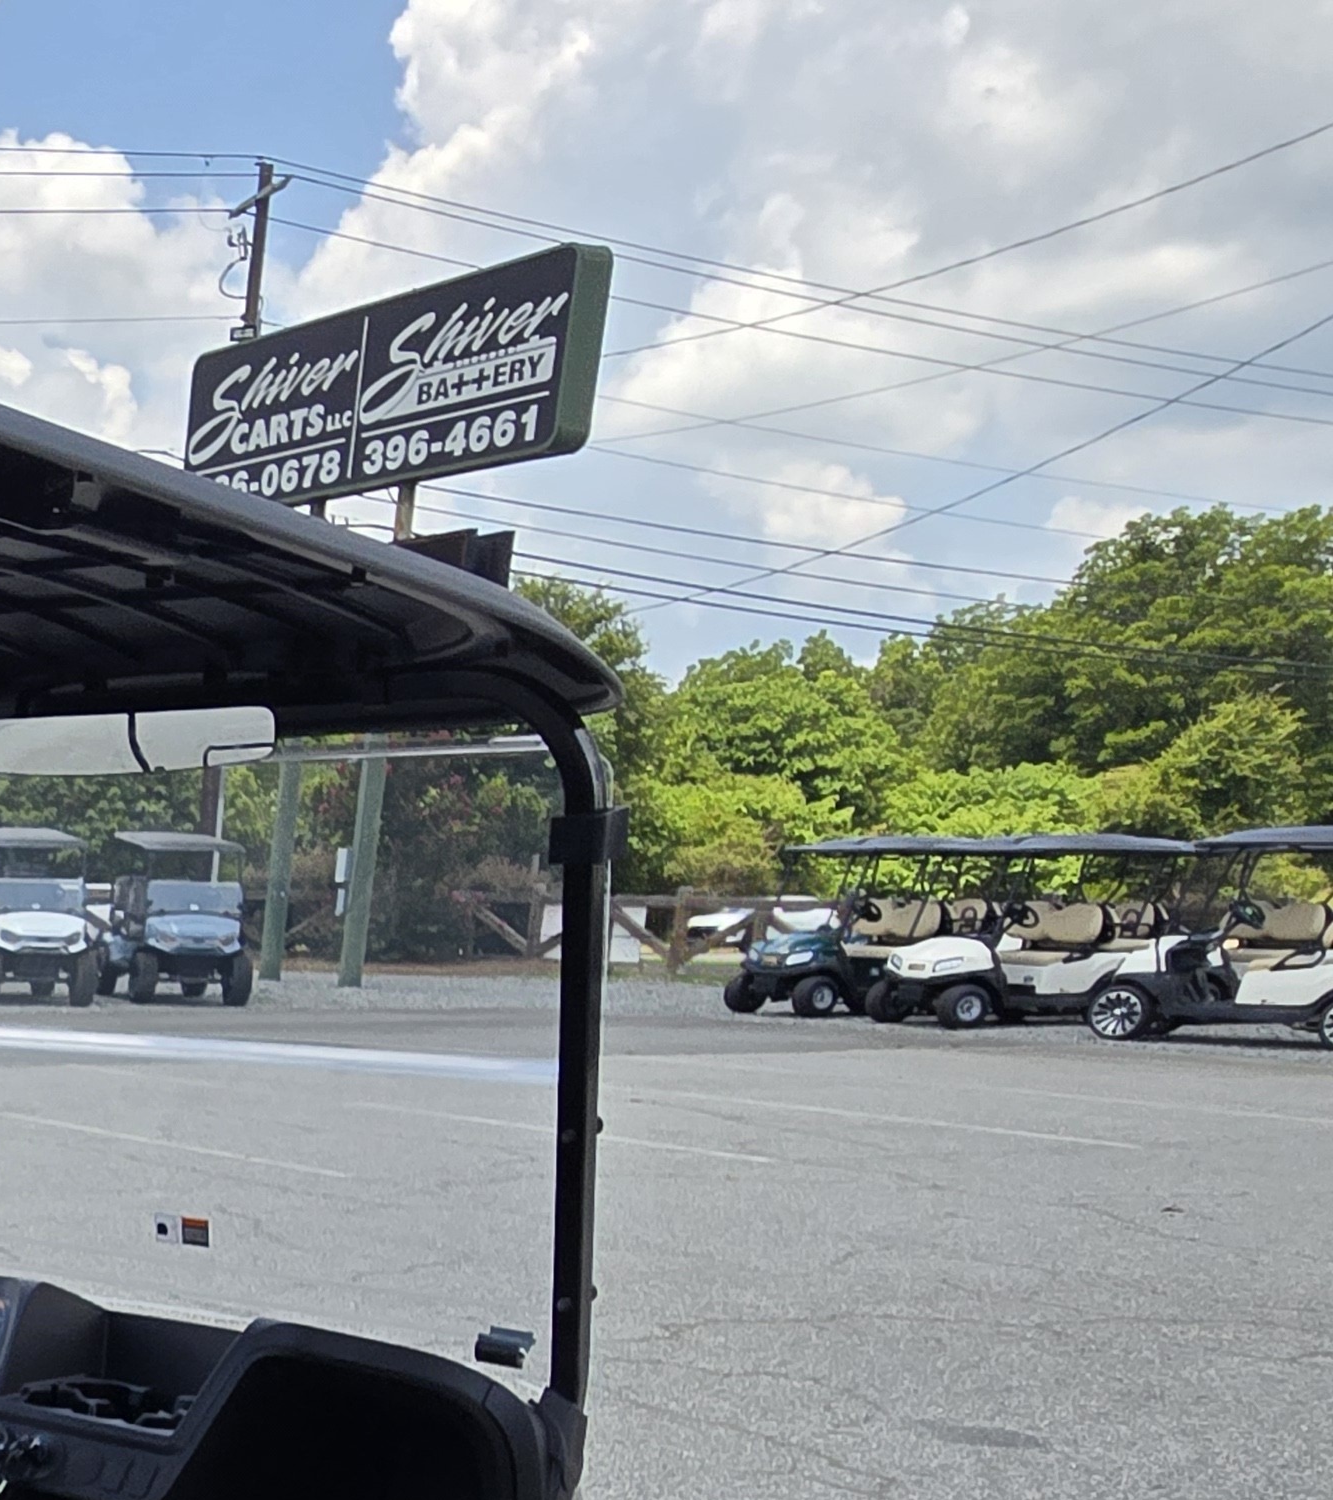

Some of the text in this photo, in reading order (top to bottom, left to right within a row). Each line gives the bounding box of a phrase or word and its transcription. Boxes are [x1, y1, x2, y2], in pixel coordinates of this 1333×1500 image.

[359, 292, 569, 425] Shiver
[188, 350, 359, 466] Shiver
[230, 403, 352, 454] CARTS LLC
[361, 404, 538, 475] 396-4661
[214, 450, 341, 497] 6-0678
